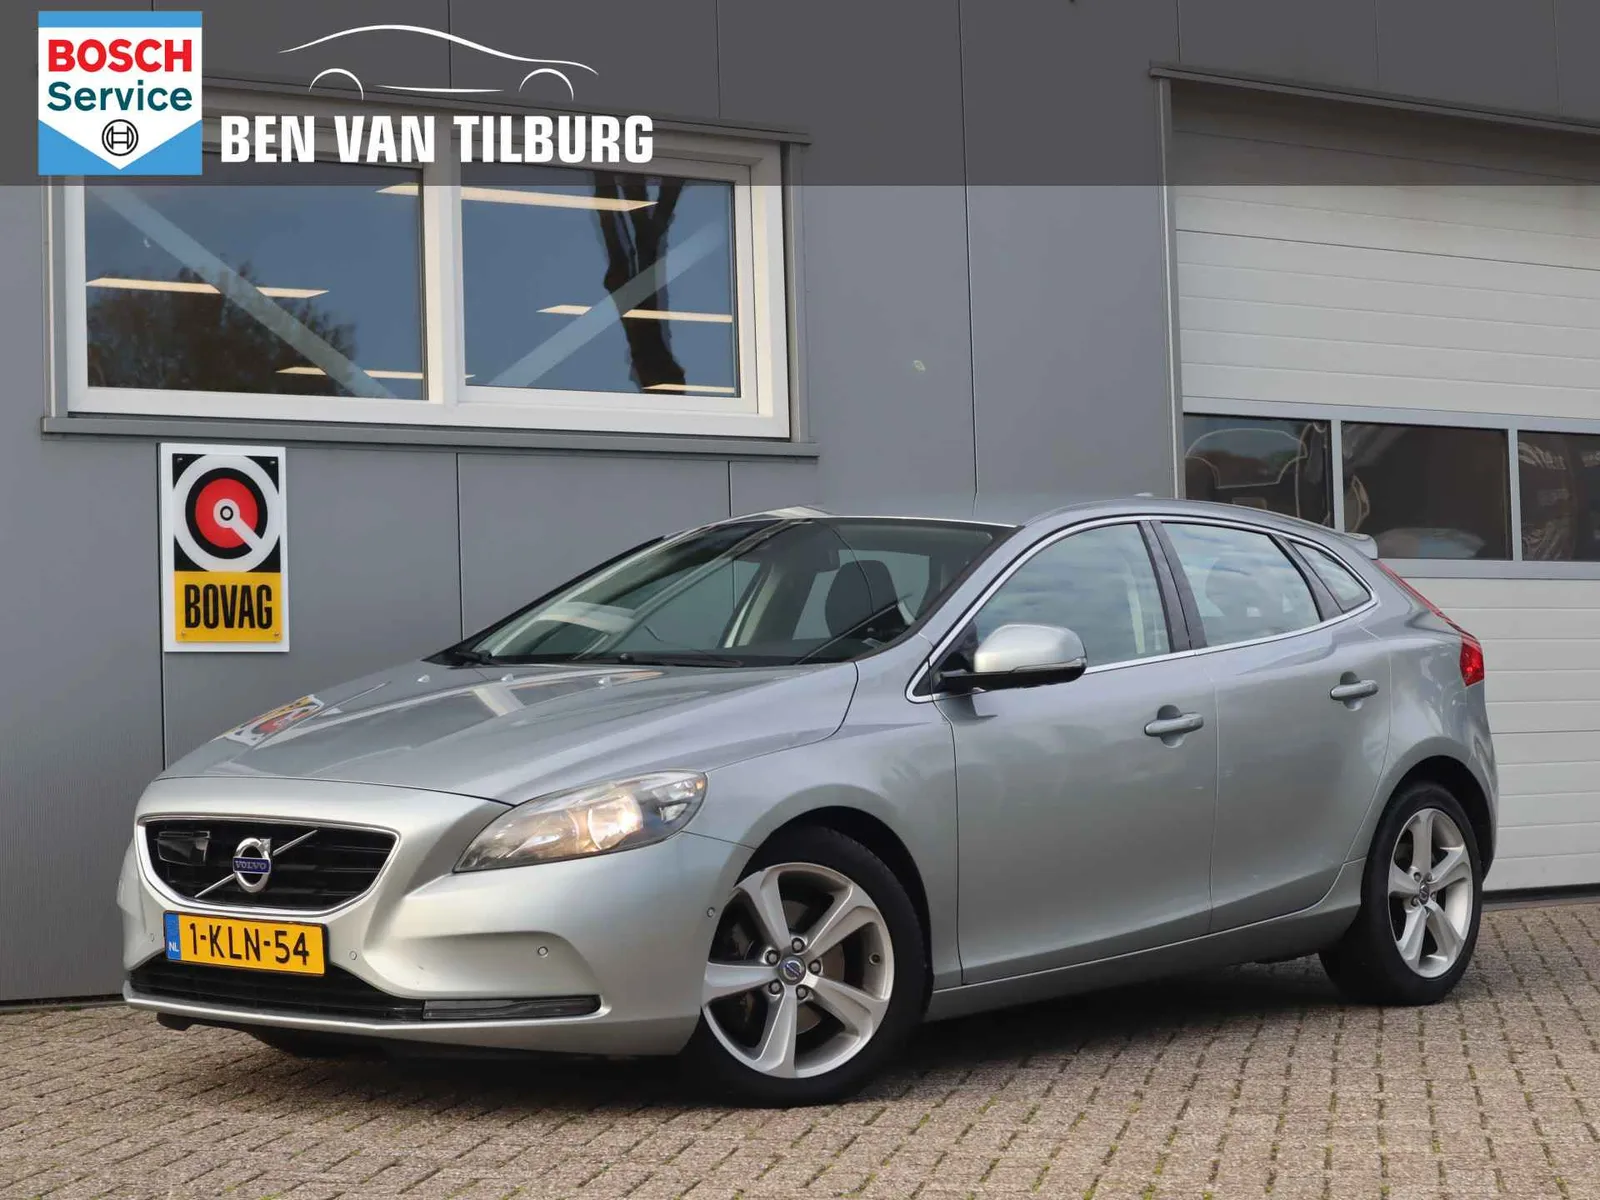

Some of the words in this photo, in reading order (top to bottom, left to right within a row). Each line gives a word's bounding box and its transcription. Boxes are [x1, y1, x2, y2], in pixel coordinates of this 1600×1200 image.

[184, 583, 273, 629] BOVAG
[234, 860, 267, 871] VOLVO
[168, 941, 180, 953] NL
[189, 922, 310, 966] 1-KLN-54
